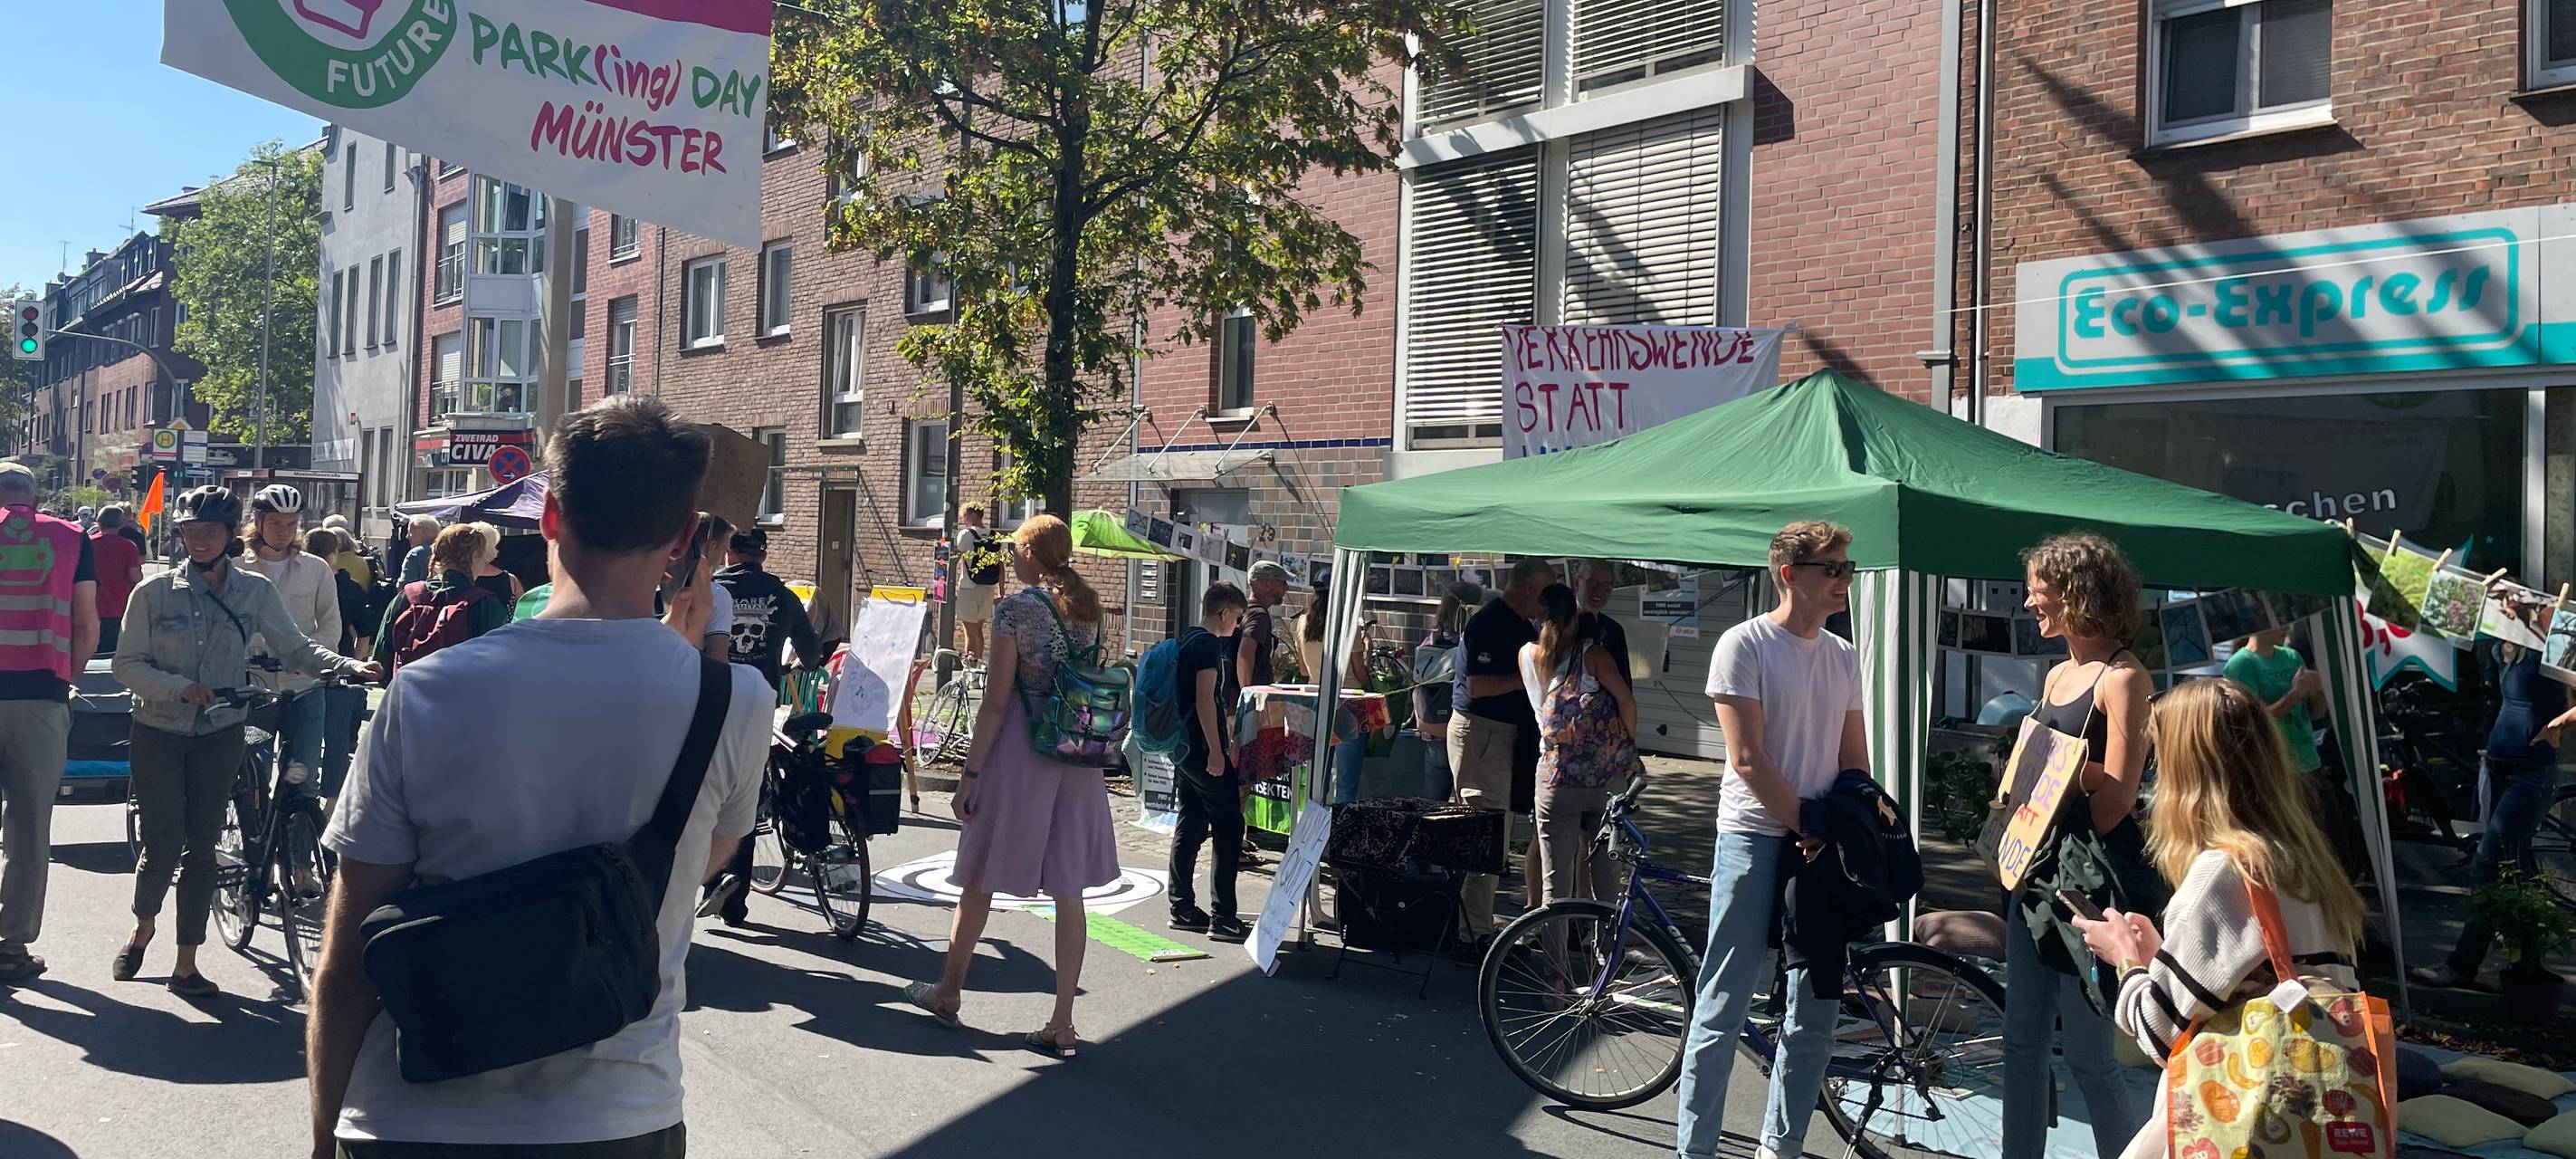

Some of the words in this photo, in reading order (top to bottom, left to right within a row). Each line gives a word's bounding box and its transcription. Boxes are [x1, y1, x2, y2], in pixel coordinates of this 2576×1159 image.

[327, 0, 450, 97] FUTURE
[467, 12, 682, 112] PARK(ing)
[692, 65, 761, 119] DAY
[530, 100, 727, 176] MÜNSTER
[2074, 264, 2490, 339] Eco-Express
[454, 434, 500, 443] ZWEIRAD
[1514, 380, 1629, 433] STATT
[451, 444, 513, 461] CIVA
